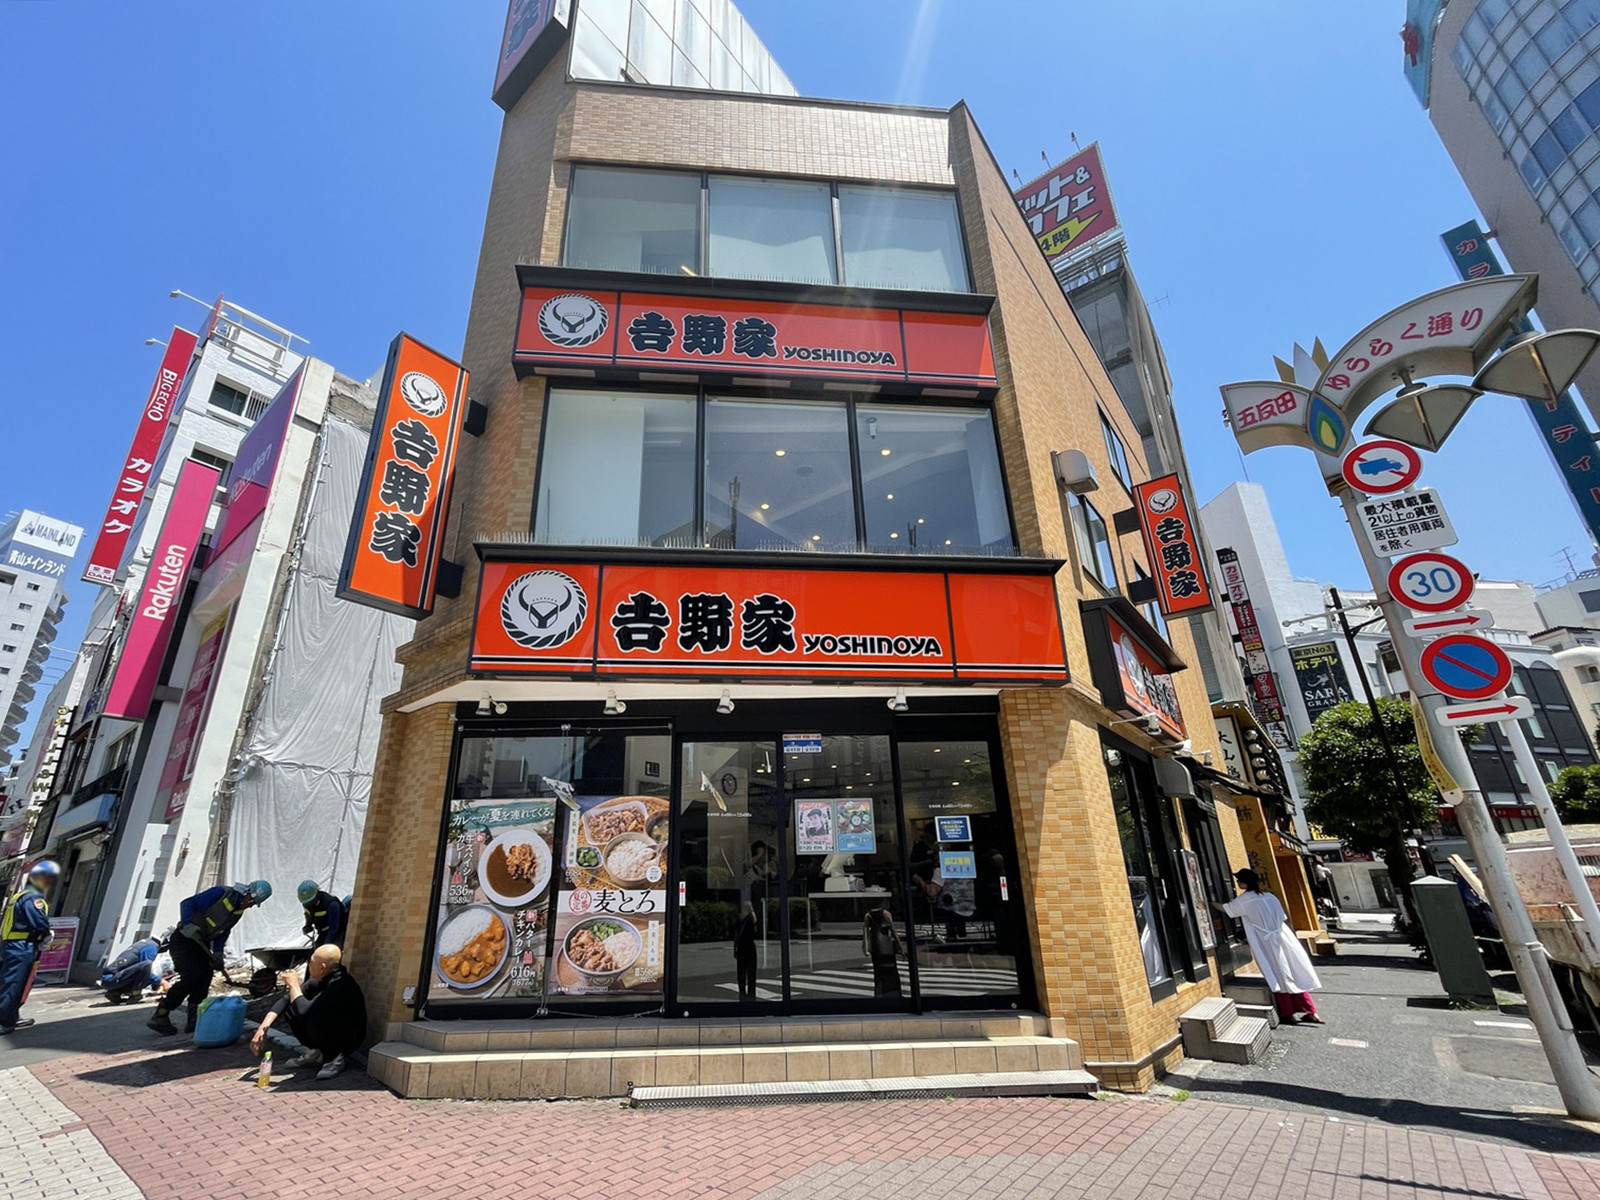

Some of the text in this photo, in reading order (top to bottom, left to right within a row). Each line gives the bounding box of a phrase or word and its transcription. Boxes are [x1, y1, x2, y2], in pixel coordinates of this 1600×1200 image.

[1041, 227, 1070, 252] 4階
[625, 311, 779, 358] 吉野家
[781, 345, 897, 366] YOSHINOYA
[1325, 306, 1483, 391] ゆうらく通り
[161, 368, 178, 392] BIG
[147, 391, 169, 422] ECHO
[1236, 390, 1297, 429] 五反田
[104, 456, 152, 535] カラオケ
[369, 418, 439, 567] 吉野家
[1364, 493, 1434, 516] 最大積載量
[35, 524, 77, 547] MAINLAND
[1373, 518, 1446, 541] 居住者用車両
[1156, 517, 1202, 598] 吉野家
[1380, 539, 1413, 552] を除く
[8, 549, 67, 577] 青山メインランド
[88, 571, 112, 581] DAM
[143, 544, 188, 621] Rakuten
[1407, 567, 1456, 597] 30
[611, 591, 796, 655] 吉野家
[802, 633, 943, 657] YOSHINOYA
[1295, 655, 1338, 671] ホテル
[1304, 686, 1348, 701] SARA
[456, 834, 465, 859] カレー
[462, 834, 475, 884] 牛スパイシー
[593, 888, 656, 914] 麦とろ
[514, 910, 526, 964] チキンカレー
[525, 921, 536, 947] バター
